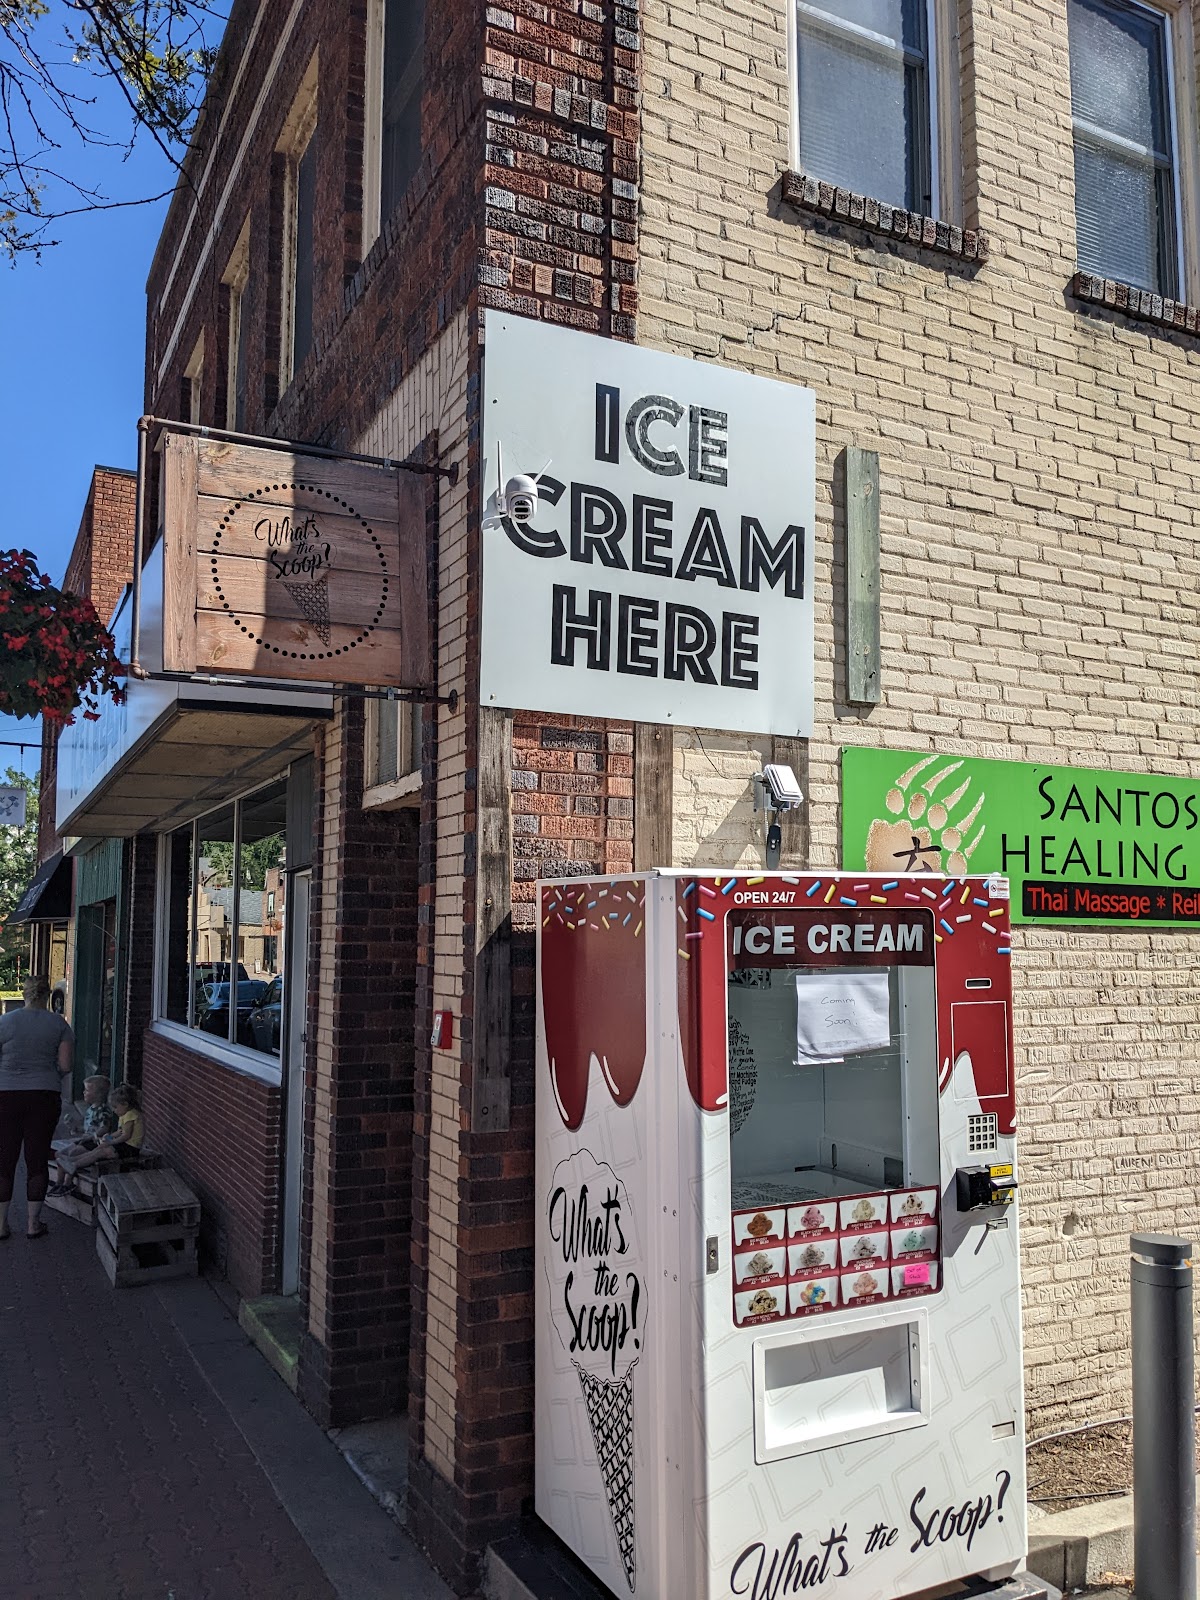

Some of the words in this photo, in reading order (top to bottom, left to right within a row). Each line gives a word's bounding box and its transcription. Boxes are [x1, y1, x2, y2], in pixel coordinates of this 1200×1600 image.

[595, 382, 728, 488] ICE
[254, 513, 324, 547] What's
[295, 540, 316, 556] the
[500, 472, 806, 600] CREAM
[269, 542, 332, 580] Scoop?
[550, 583, 760, 691] HERE
[1038, 775, 1198, 830] SANTOS
[1001, 833, 1187, 881] HEALING
[733, 891, 769, 905] OPEN
[771, 890, 796, 904] 24/7
[1027, 887, 1069, 912] Thai
[1075, 889, 1151, 919] Massage
[732, 925, 796, 955] ICE
[807, 923, 924, 954] CREAM
[820, 997, 856, 1006] Coming
[824, 1012, 858, 1027] Soon!
[1115, 1156, 1153, 1170] LAUREN!
[549, 1184, 630, 1263] What's
[593, 1260, 620, 1297] the
[564, 1270, 641, 1377] Scoop?
[730, 1523, 854, 1600] What's
[864, 1522, 899, 1555] the
[909, 1469, 1011, 1553] Scoop?
